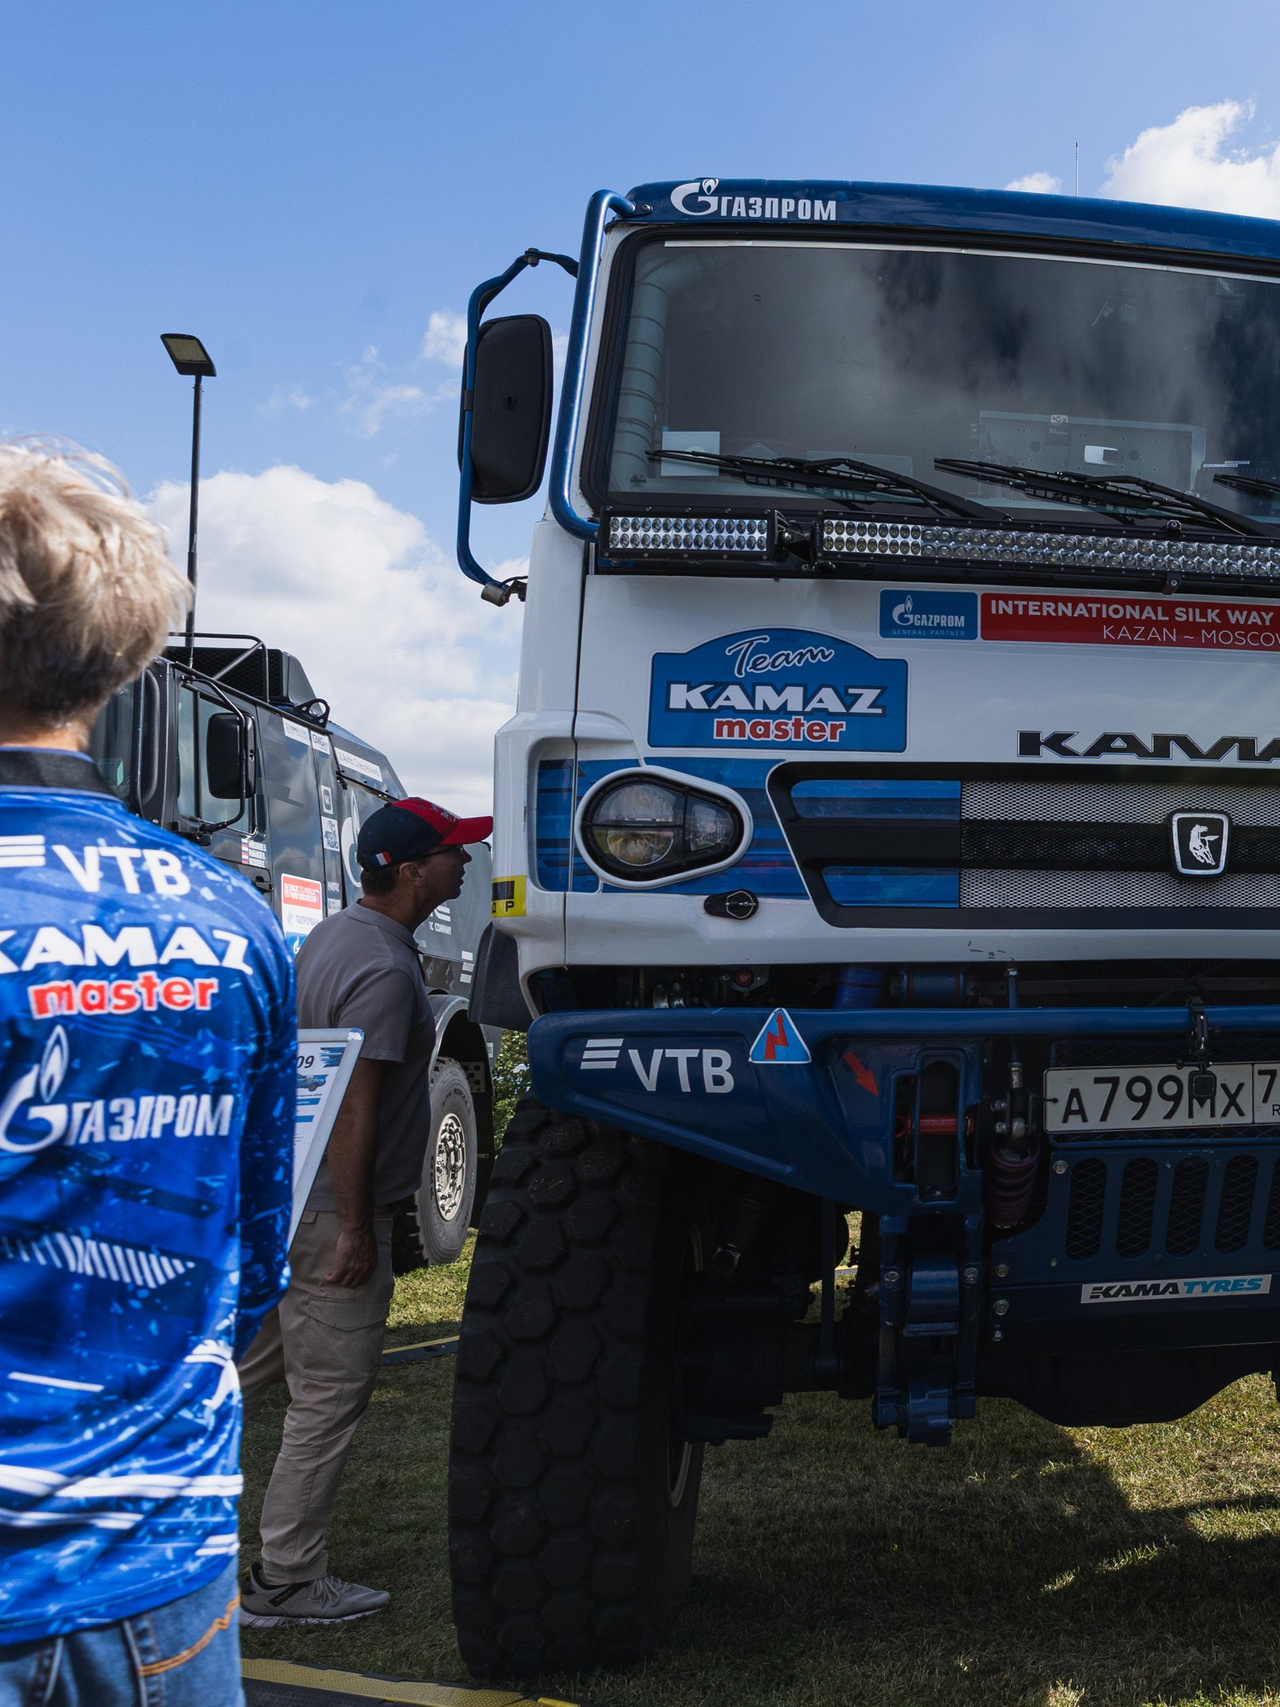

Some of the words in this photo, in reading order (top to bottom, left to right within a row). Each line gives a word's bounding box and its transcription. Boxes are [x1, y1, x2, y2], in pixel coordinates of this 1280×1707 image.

[720, 195, 837, 222] ГАЗПРОМ
[914, 614, 965, 628] GAZPROM
[990, 599, 1170, 622] INTERNATIONAL
[1174, 607, 1222, 624] SILK
[1226, 609, 1277, 627] WAY
[891, 628, 927, 636] GENERAL
[930, 629, 966, 637] PARTNER
[1102, 625, 1177, 642] KAZAN
[726, 634, 835, 679] Team
[667, 682, 885, 715] KAMAZ
[713, 715, 847, 743] master
[52, 845, 192, 896] VTB
[28, 971, 219, 1020] master
[627, 1048, 735, 1094] VTB
[64, 1094, 235, 1146] ГАЗПРОМ
[1089, 1281, 1180, 1299] KAMA
[1183, 1278, 1264, 1294] TYRES
